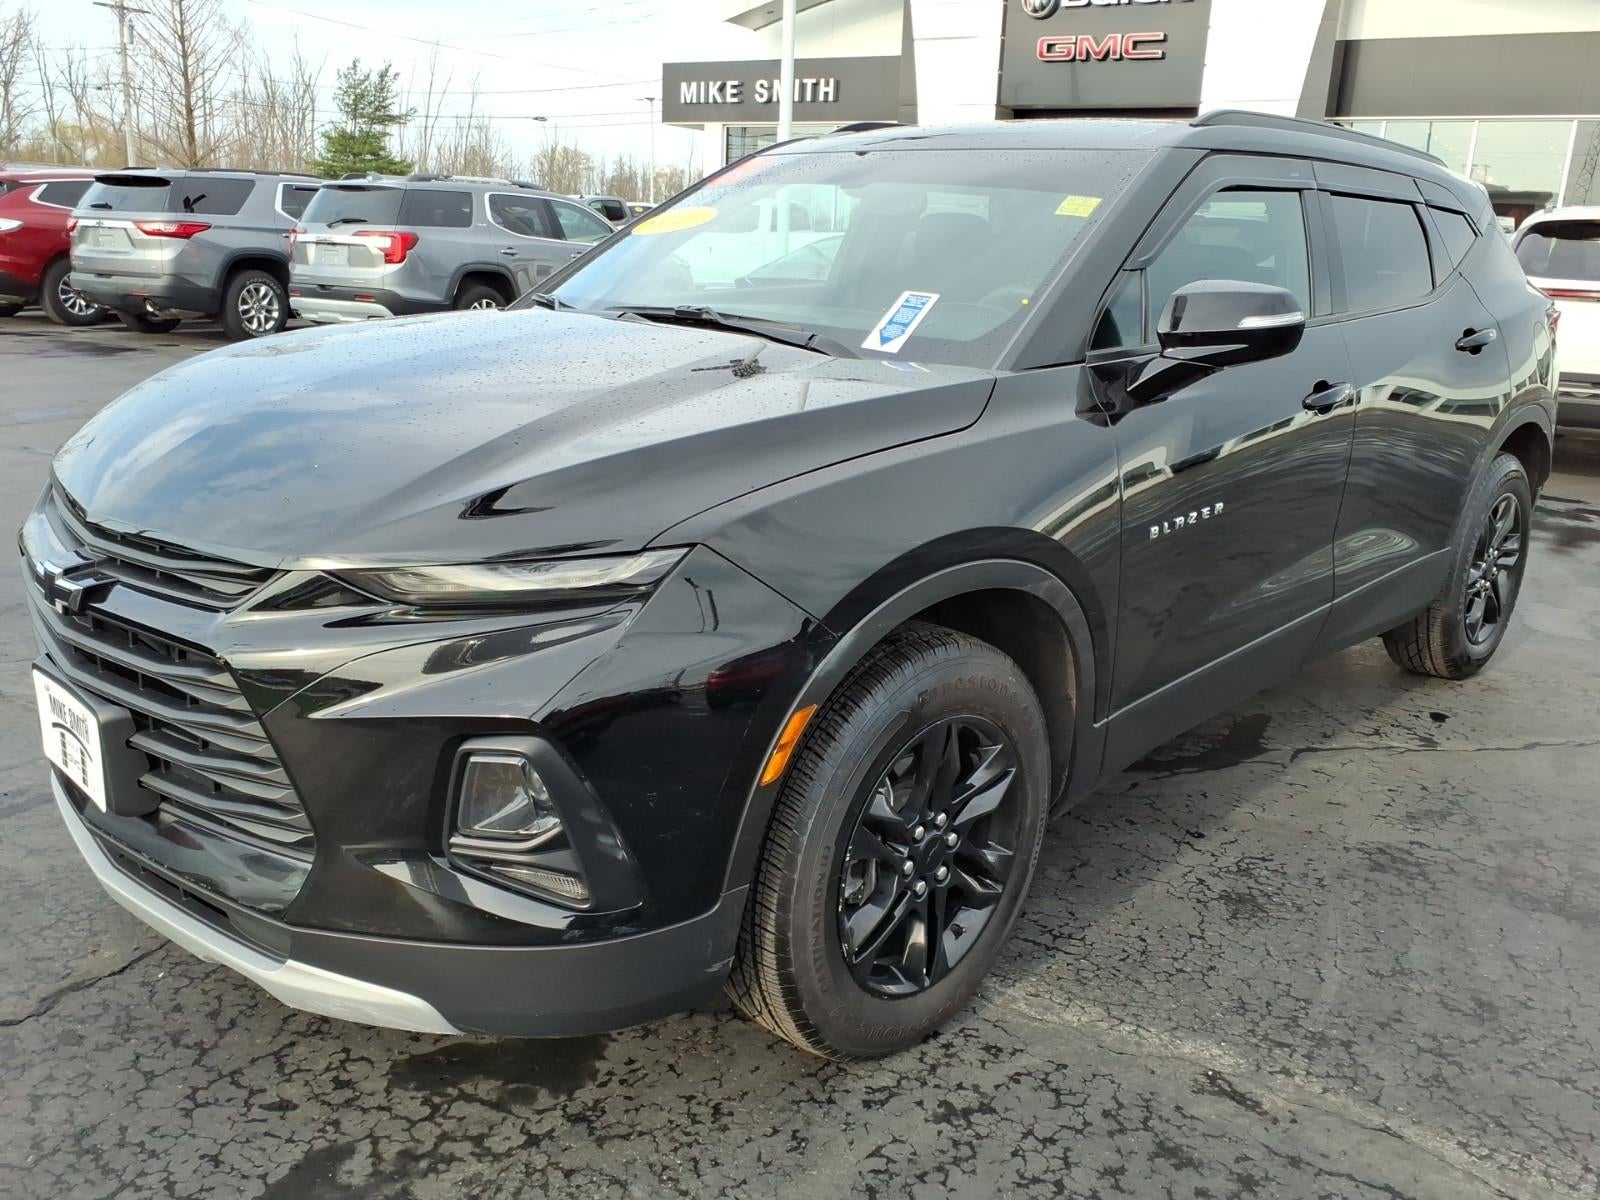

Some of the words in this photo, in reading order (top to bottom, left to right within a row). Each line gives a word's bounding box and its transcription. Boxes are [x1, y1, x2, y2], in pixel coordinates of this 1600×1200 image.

[1036, 31, 1165, 61] GMC
[680, 80, 739, 104] MIKE
[1149, 502, 1224, 540] BLAZER
[49, 693, 68, 724] MIKE
[68, 707, 90, 745] SMITH
